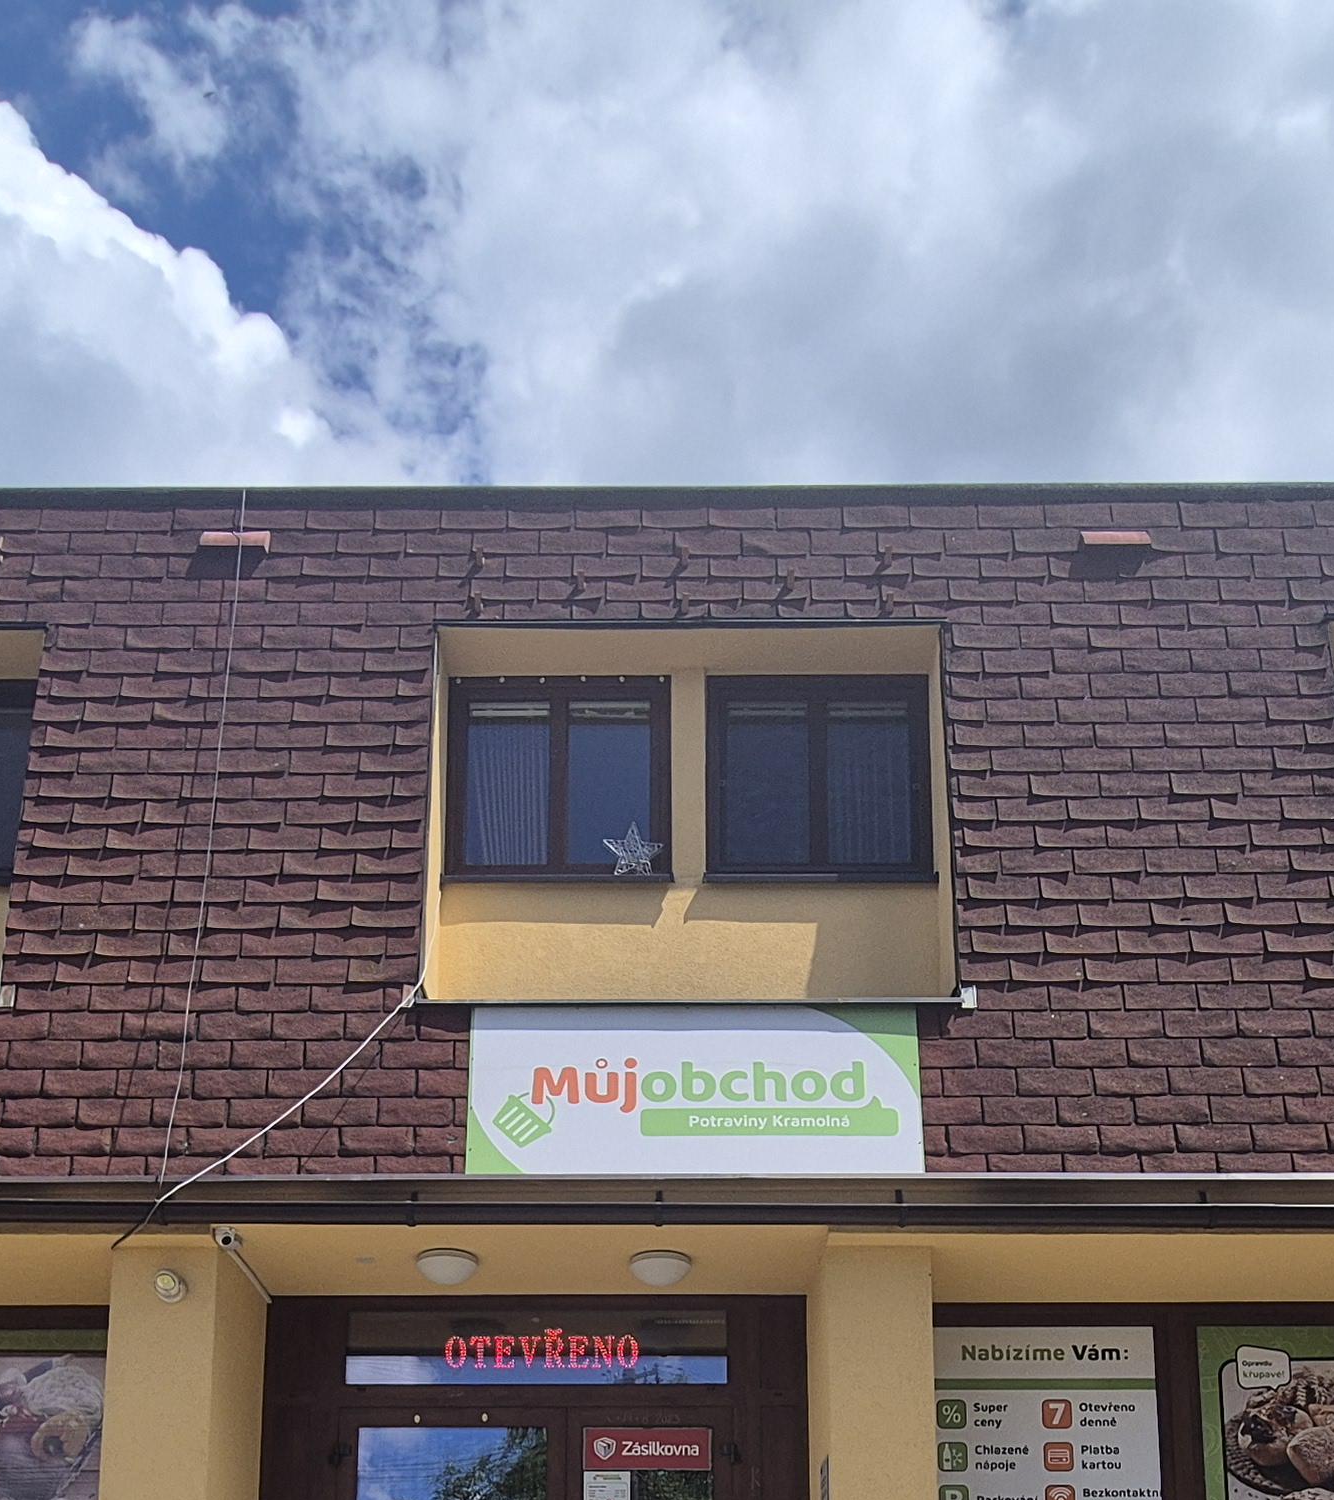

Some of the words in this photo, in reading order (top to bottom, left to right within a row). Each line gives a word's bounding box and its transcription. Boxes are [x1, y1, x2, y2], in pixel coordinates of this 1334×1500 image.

[688, 1115, 767, 1130] Potraviny
[772, 1115, 850, 1128] Kramolná
[444, 1328, 640, 1369] OTEVŘENO
[961, 1344, 1065, 1361] Nabízíme
[1071, 1344, 1129, 1361] Vám:
[973, 1403, 1008, 1415] Super
[1079, 1402, 1136, 1412] Otevřeno
[973, 1418, 1002, 1429] ceny
[1080, 1416, 1117, 1427] denně
[621, 1441, 699, 1456] Zásilkovna
[974, 1445, 1029, 1456] Chlazené
[1081, 1444, 1120, 1455] Platba
[975, 1461, 1016, 1472] nápoje
[1081, 1461, 1122, 1470] kartou
[1083, 1488, 1161, 1498] Bezkontaktn
